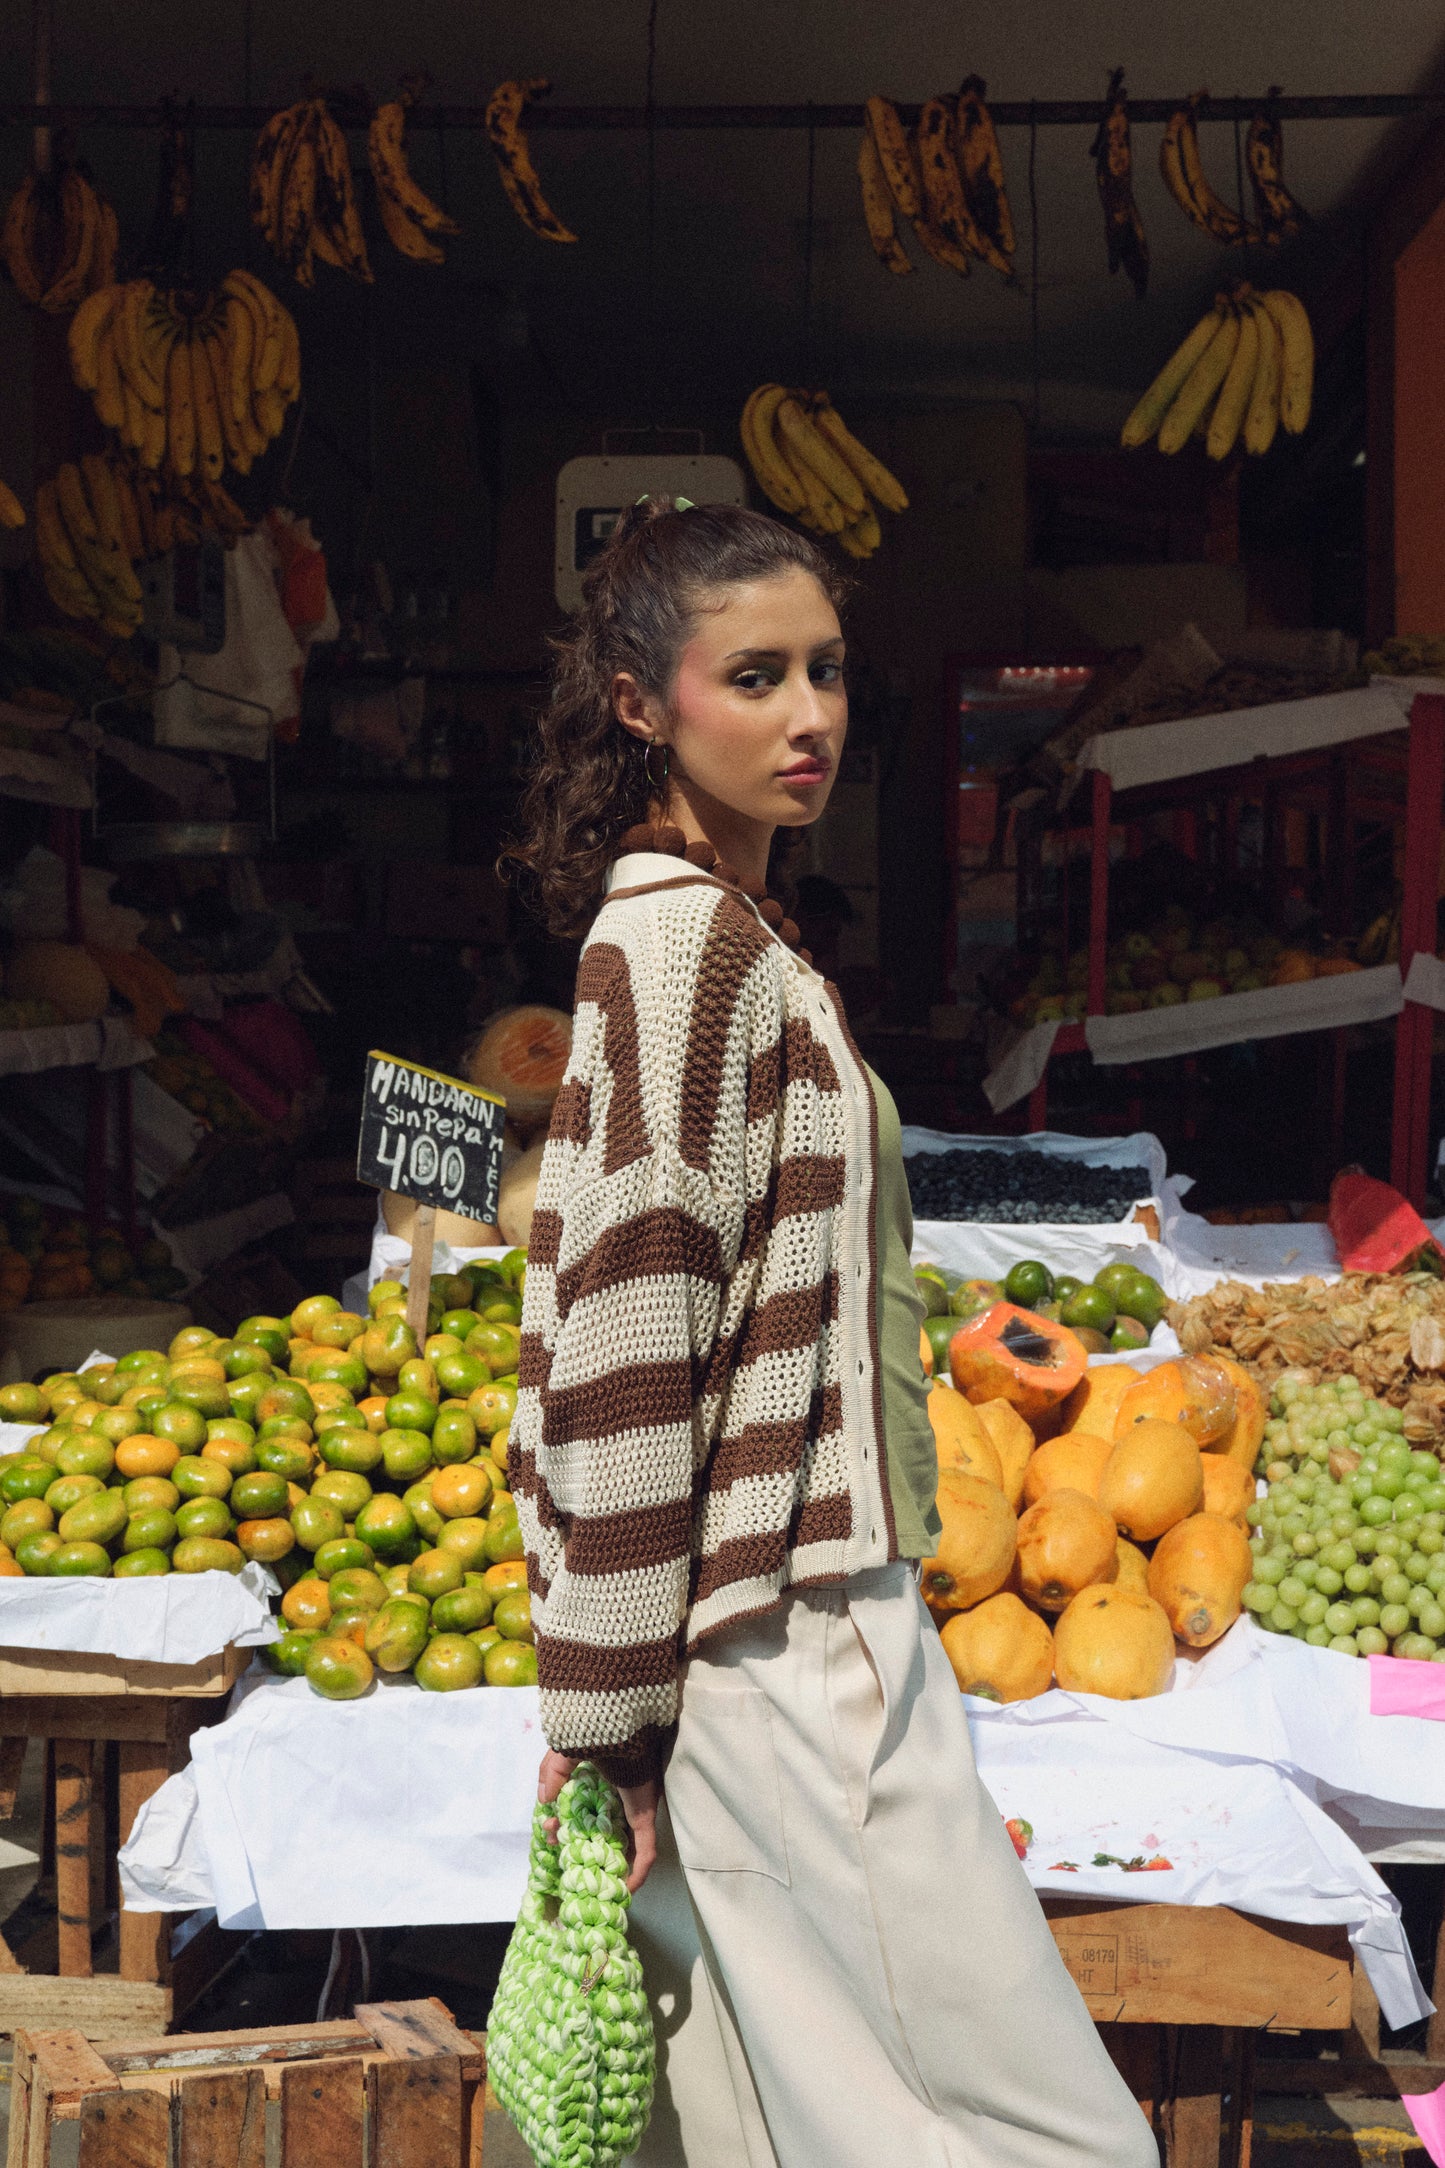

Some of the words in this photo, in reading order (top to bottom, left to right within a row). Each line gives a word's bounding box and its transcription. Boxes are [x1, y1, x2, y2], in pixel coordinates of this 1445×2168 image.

[371, 1060, 495, 1129] MANDARIN
[1082, 1949, 1115, 1964] 08179
[1078, 1969, 1095, 1983] HT
